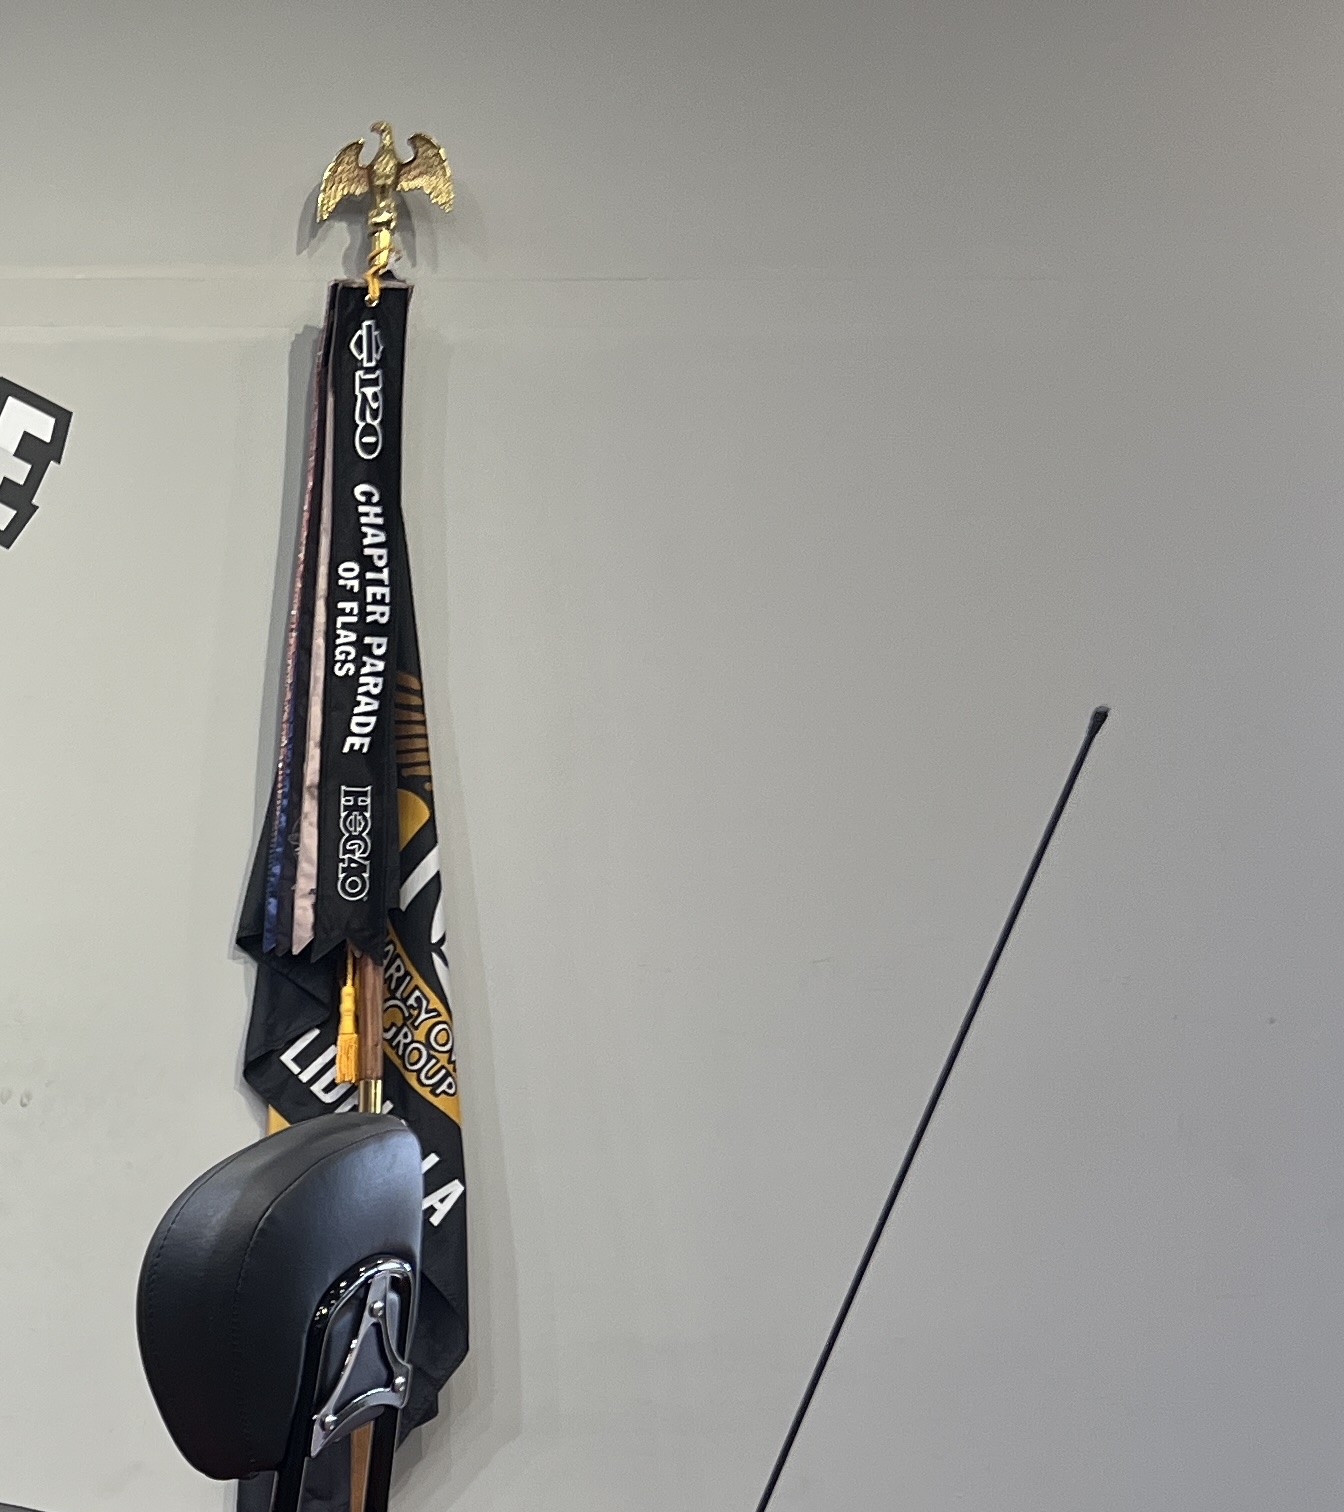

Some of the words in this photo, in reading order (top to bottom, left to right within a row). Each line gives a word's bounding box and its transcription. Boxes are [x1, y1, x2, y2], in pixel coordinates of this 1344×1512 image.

[336, 560, 361, 594] OF
[353, 482, 391, 624] CHAPTER
[334, 600, 359, 677] FLAGS
[341, 635, 389, 753] PARADE
